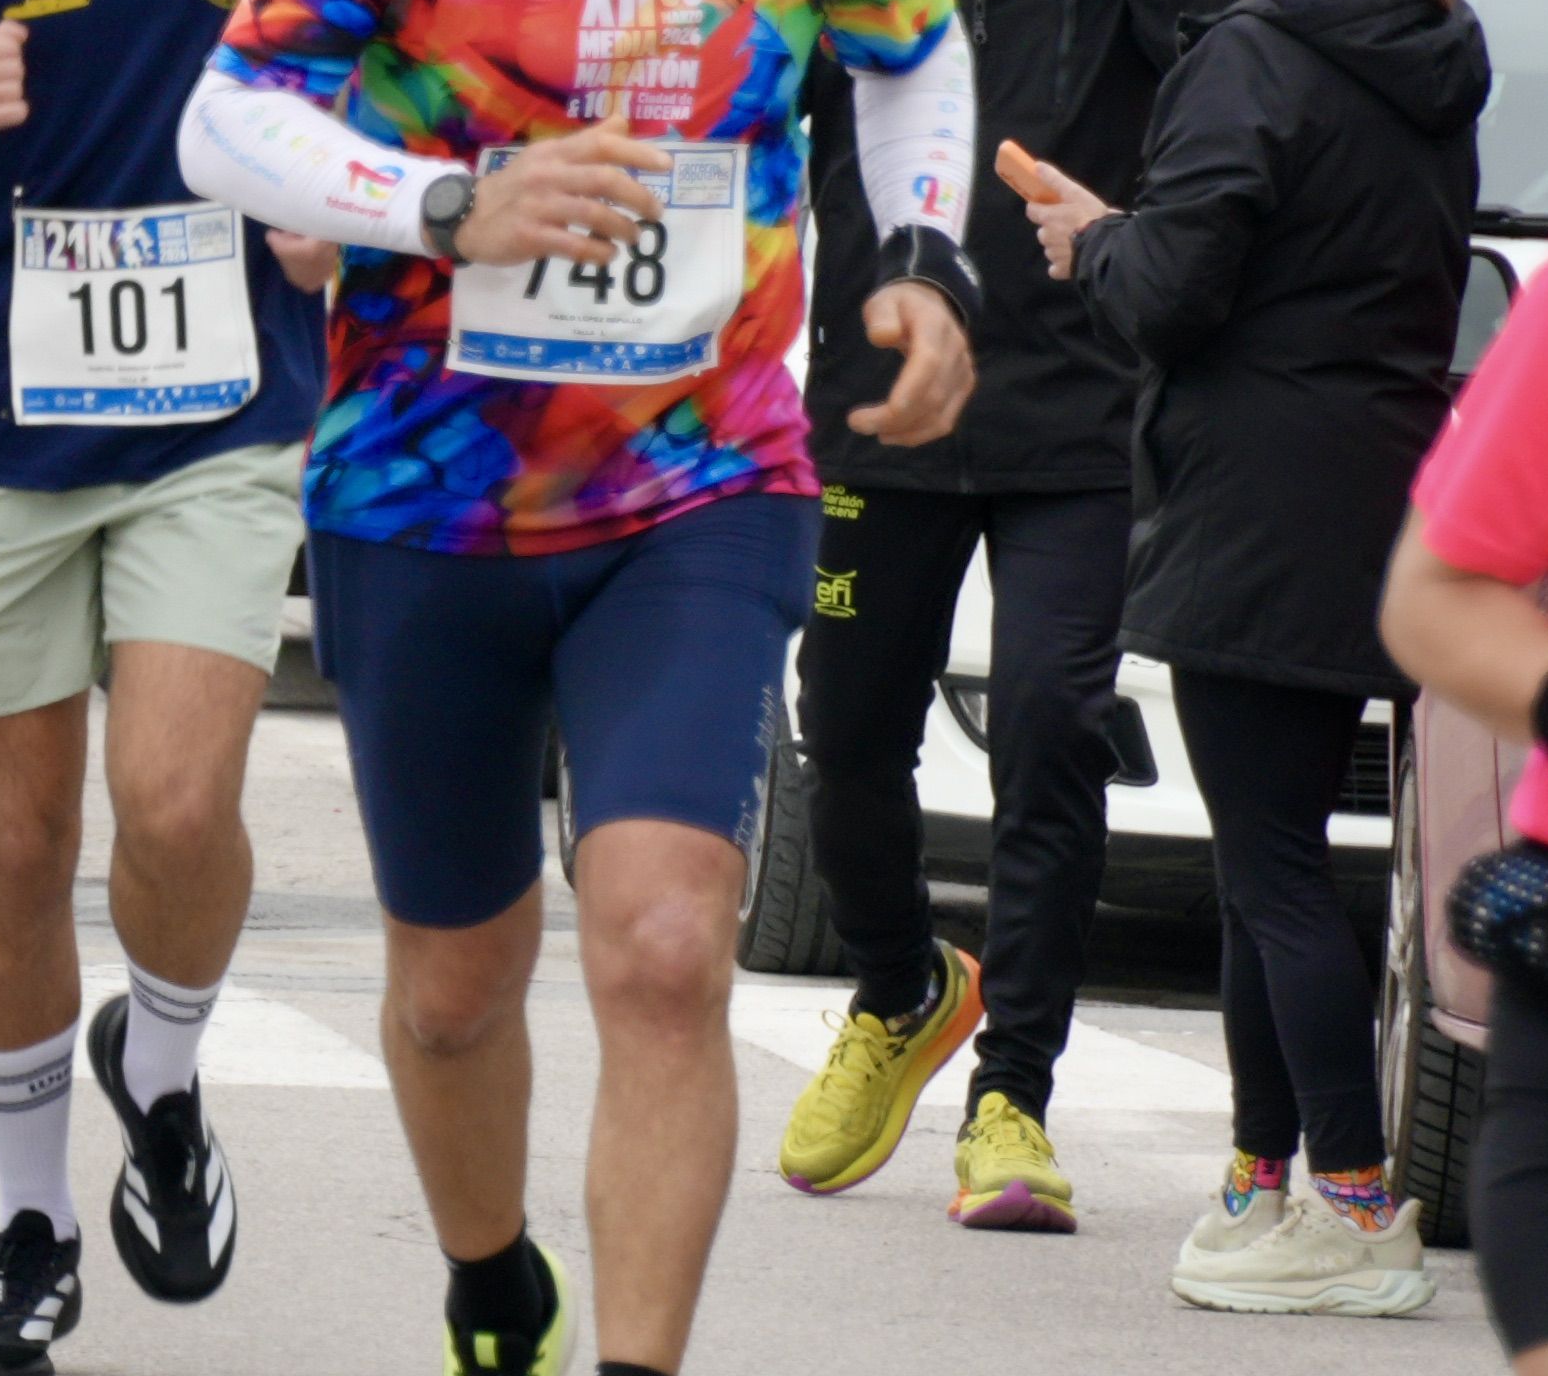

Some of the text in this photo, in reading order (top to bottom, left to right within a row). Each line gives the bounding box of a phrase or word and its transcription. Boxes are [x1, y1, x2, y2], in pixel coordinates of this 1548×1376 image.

[579, 29, 657, 59] MEDIA
[661, 28, 702, 46] 2026
[574, 51, 701, 89] MARATÓN
[636, 105, 692, 120] LUCENA
[637, 92, 677, 104] Ciudad
[47, 220, 117, 271] 21K
[68, 276, 188, 356] 101
[823, 505, 859, 520] ucena
[816, 577, 851, 606] efi
